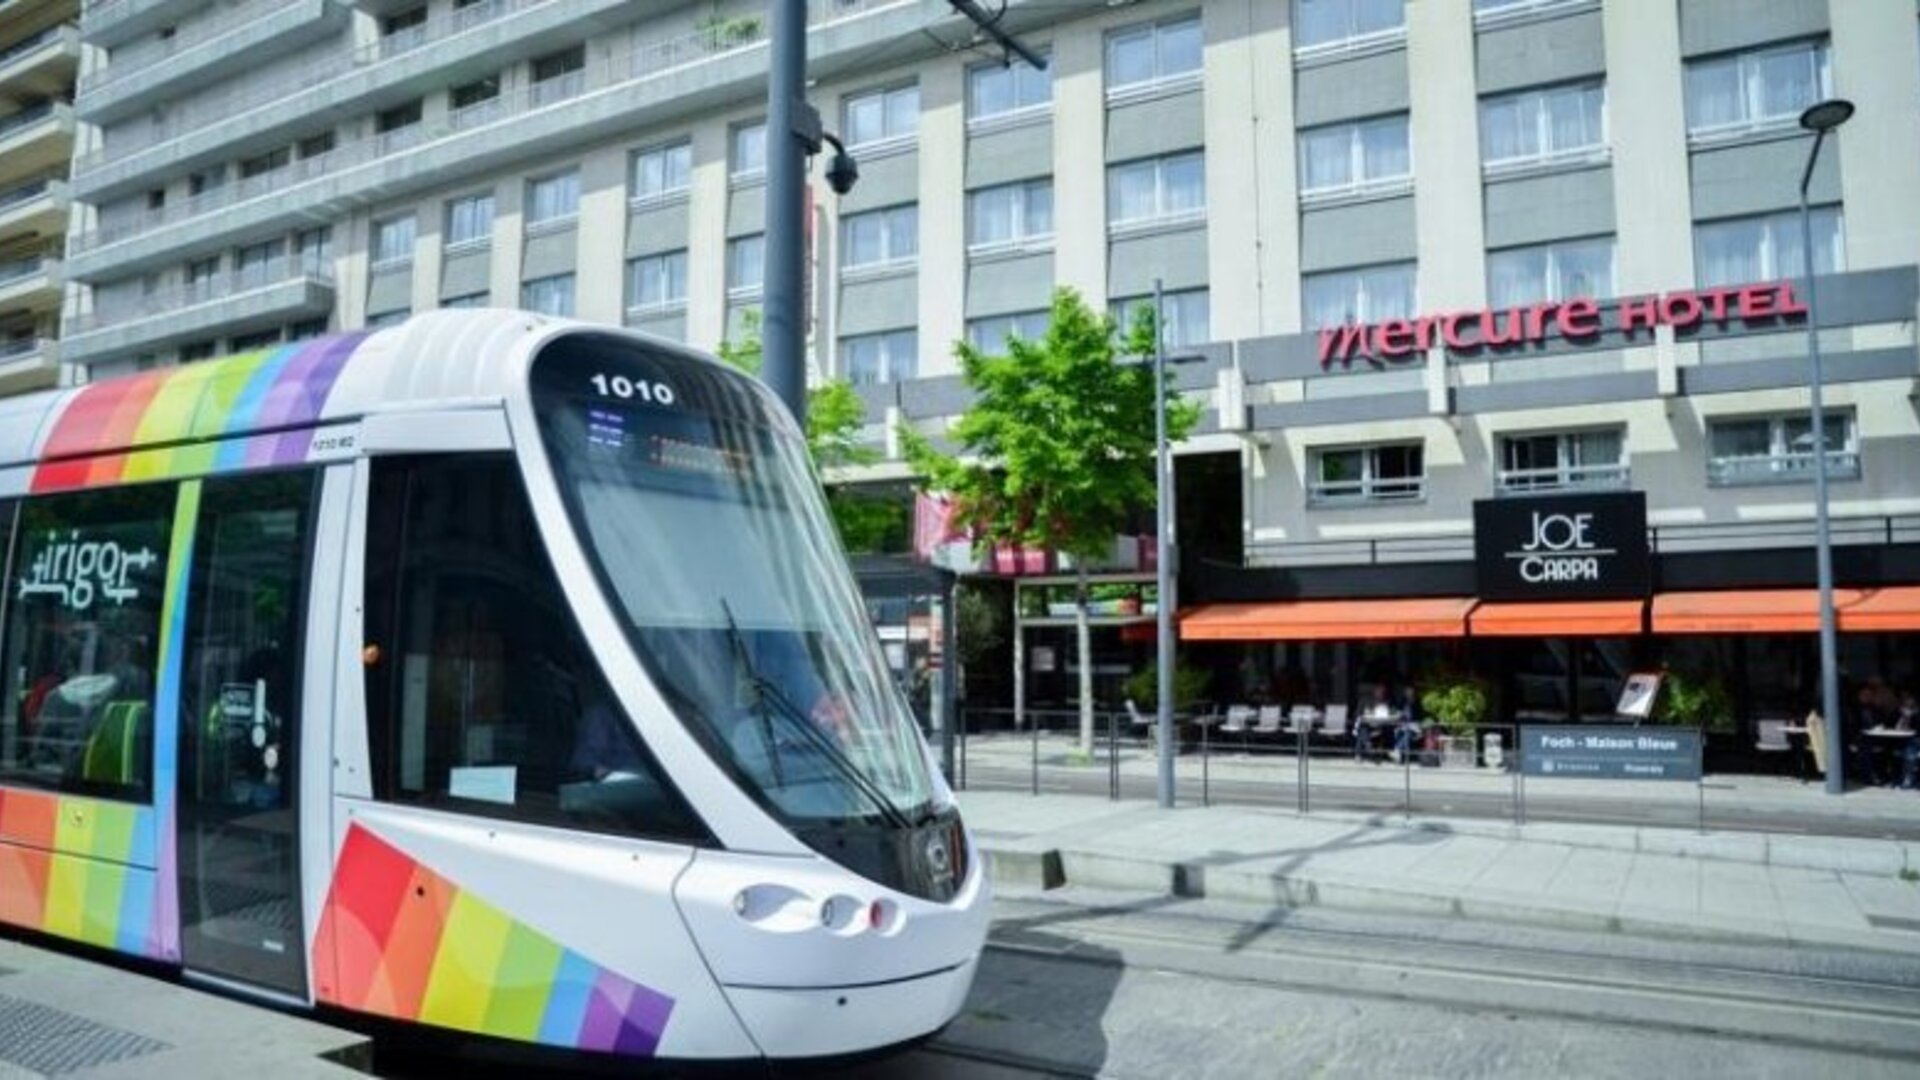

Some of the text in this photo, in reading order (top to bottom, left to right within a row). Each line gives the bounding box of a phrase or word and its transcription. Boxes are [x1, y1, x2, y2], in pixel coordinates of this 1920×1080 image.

[1621, 279, 1809, 331] HOTEL
[590, 373, 675, 405] 1010
[1521, 511, 1595, 550] JOE
[1519, 556, 1599, 582] CARPA
[1541, 736, 1575, 748] Foch
[1584, 736, 1635, 749] Maison
[1637, 736, 1678, 750] Bleue
